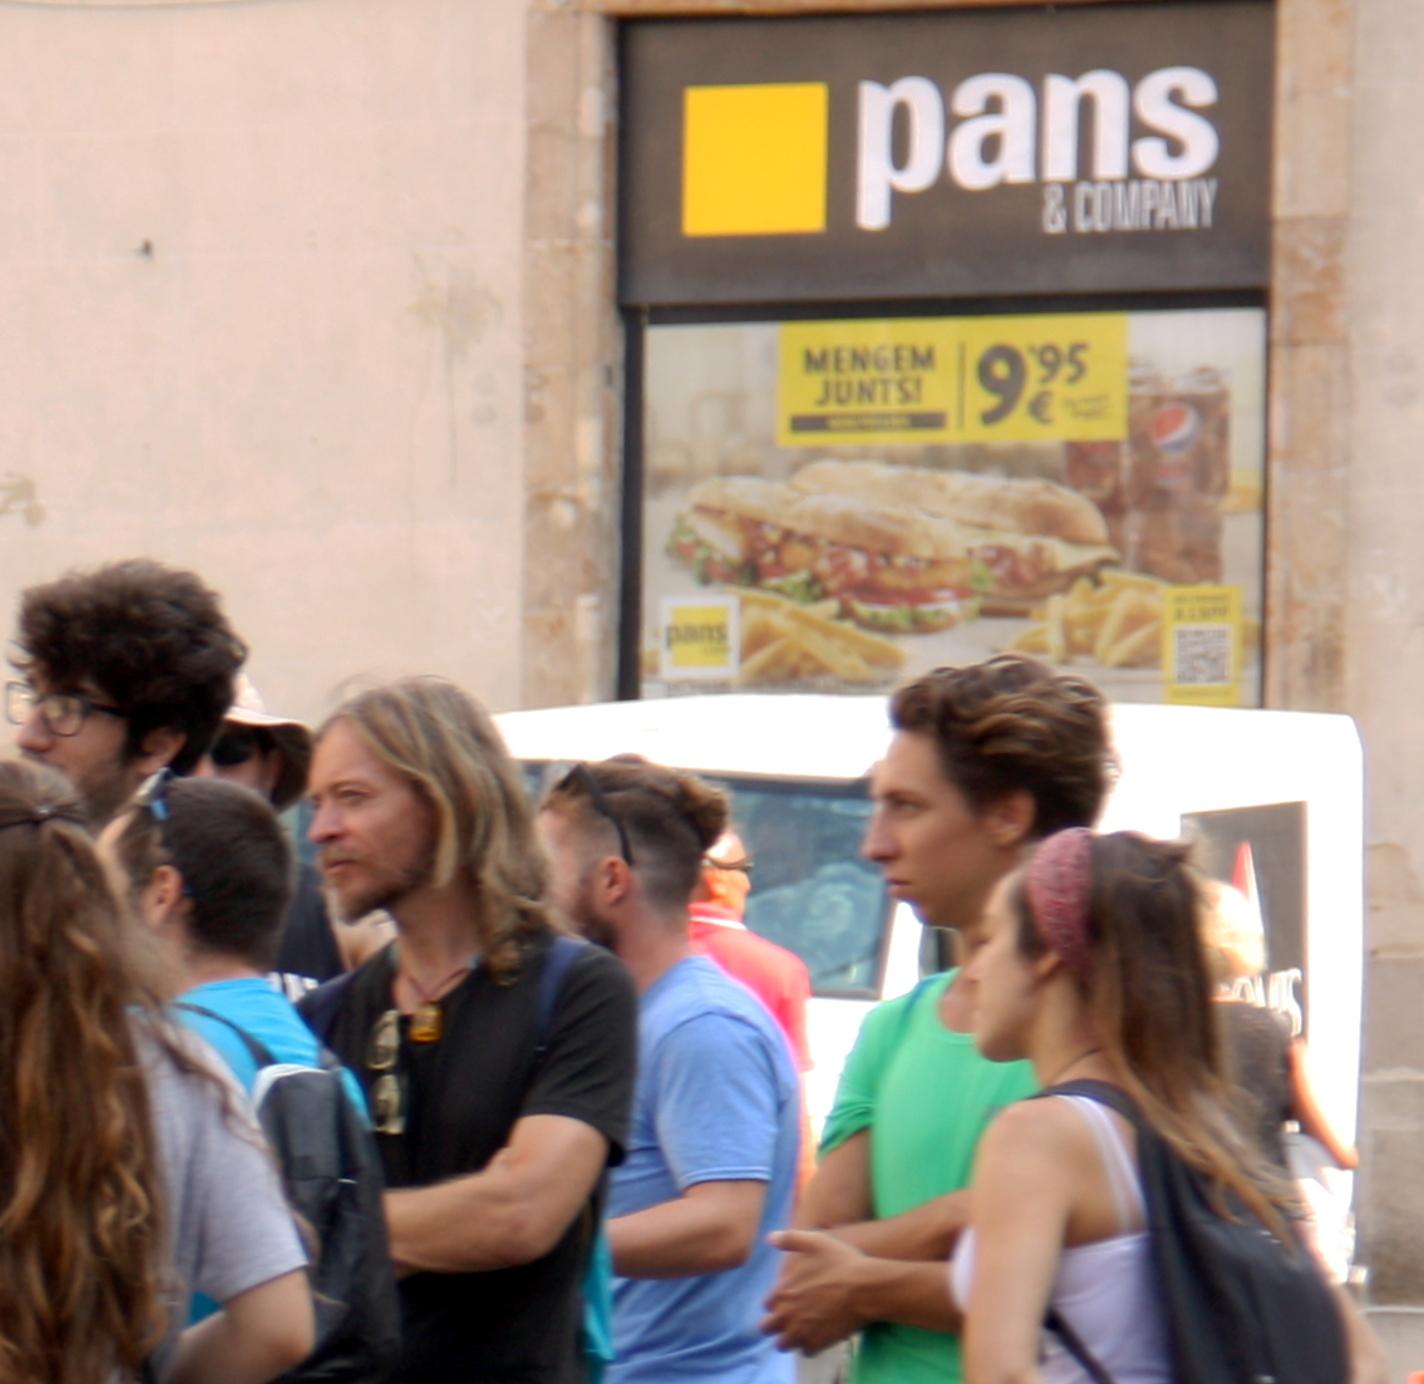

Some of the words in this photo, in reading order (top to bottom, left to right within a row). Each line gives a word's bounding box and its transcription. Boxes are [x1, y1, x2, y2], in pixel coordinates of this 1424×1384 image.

[856, 66, 1219, 232] pans
[1042, 185, 1067, 234] &
[1074, 180, 1217, 232] COMPANY
[804, 345, 935, 374] MENGEM
[816, 376, 924, 408] JUNTS!
[665, 623, 728, 653] pans
